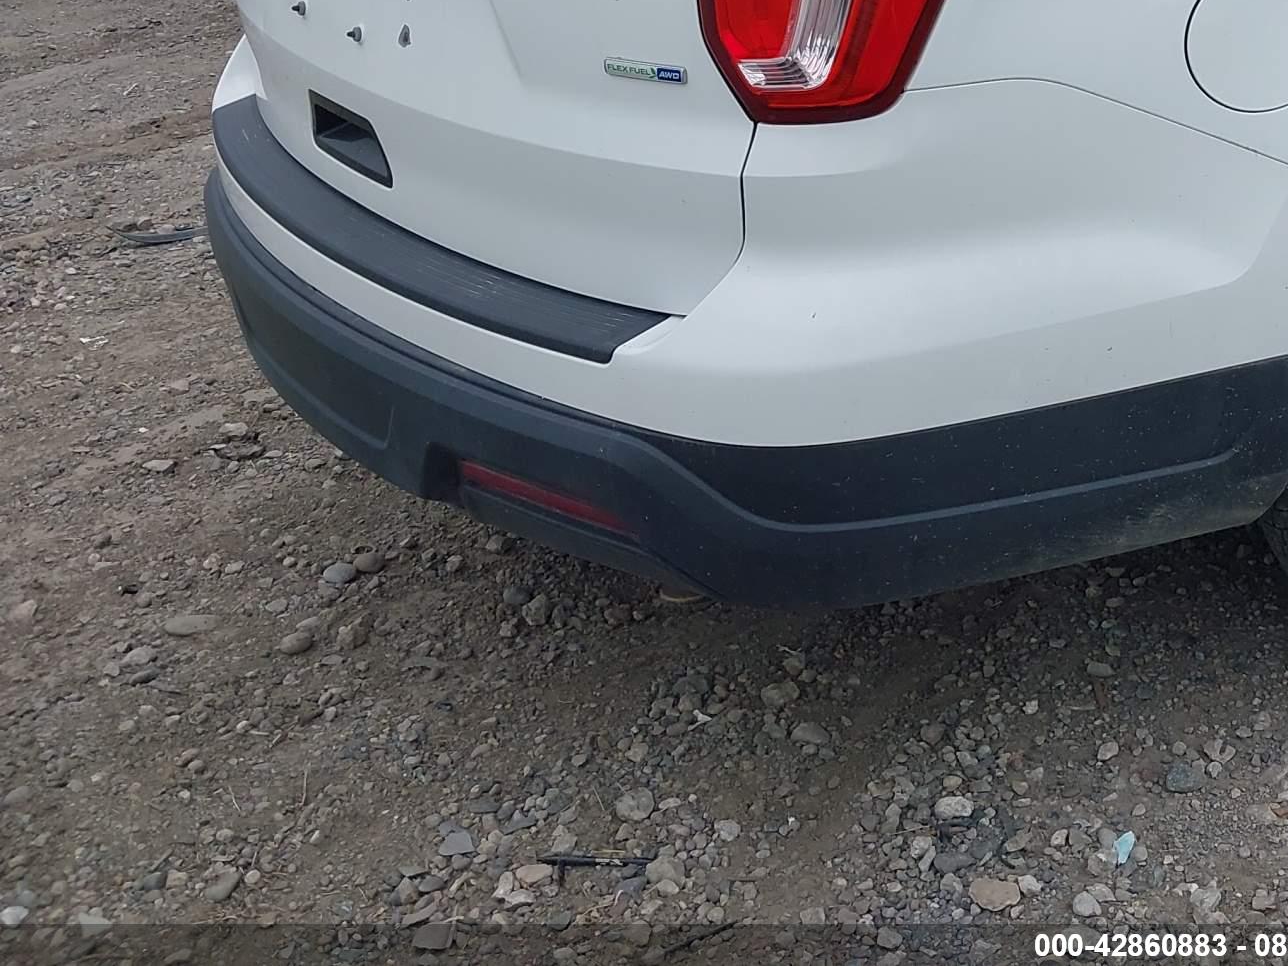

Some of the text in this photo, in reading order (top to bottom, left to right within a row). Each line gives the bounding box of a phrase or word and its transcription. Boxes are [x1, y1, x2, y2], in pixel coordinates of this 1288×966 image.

[606, 63, 681, 80] FLEX FUEL AWD
